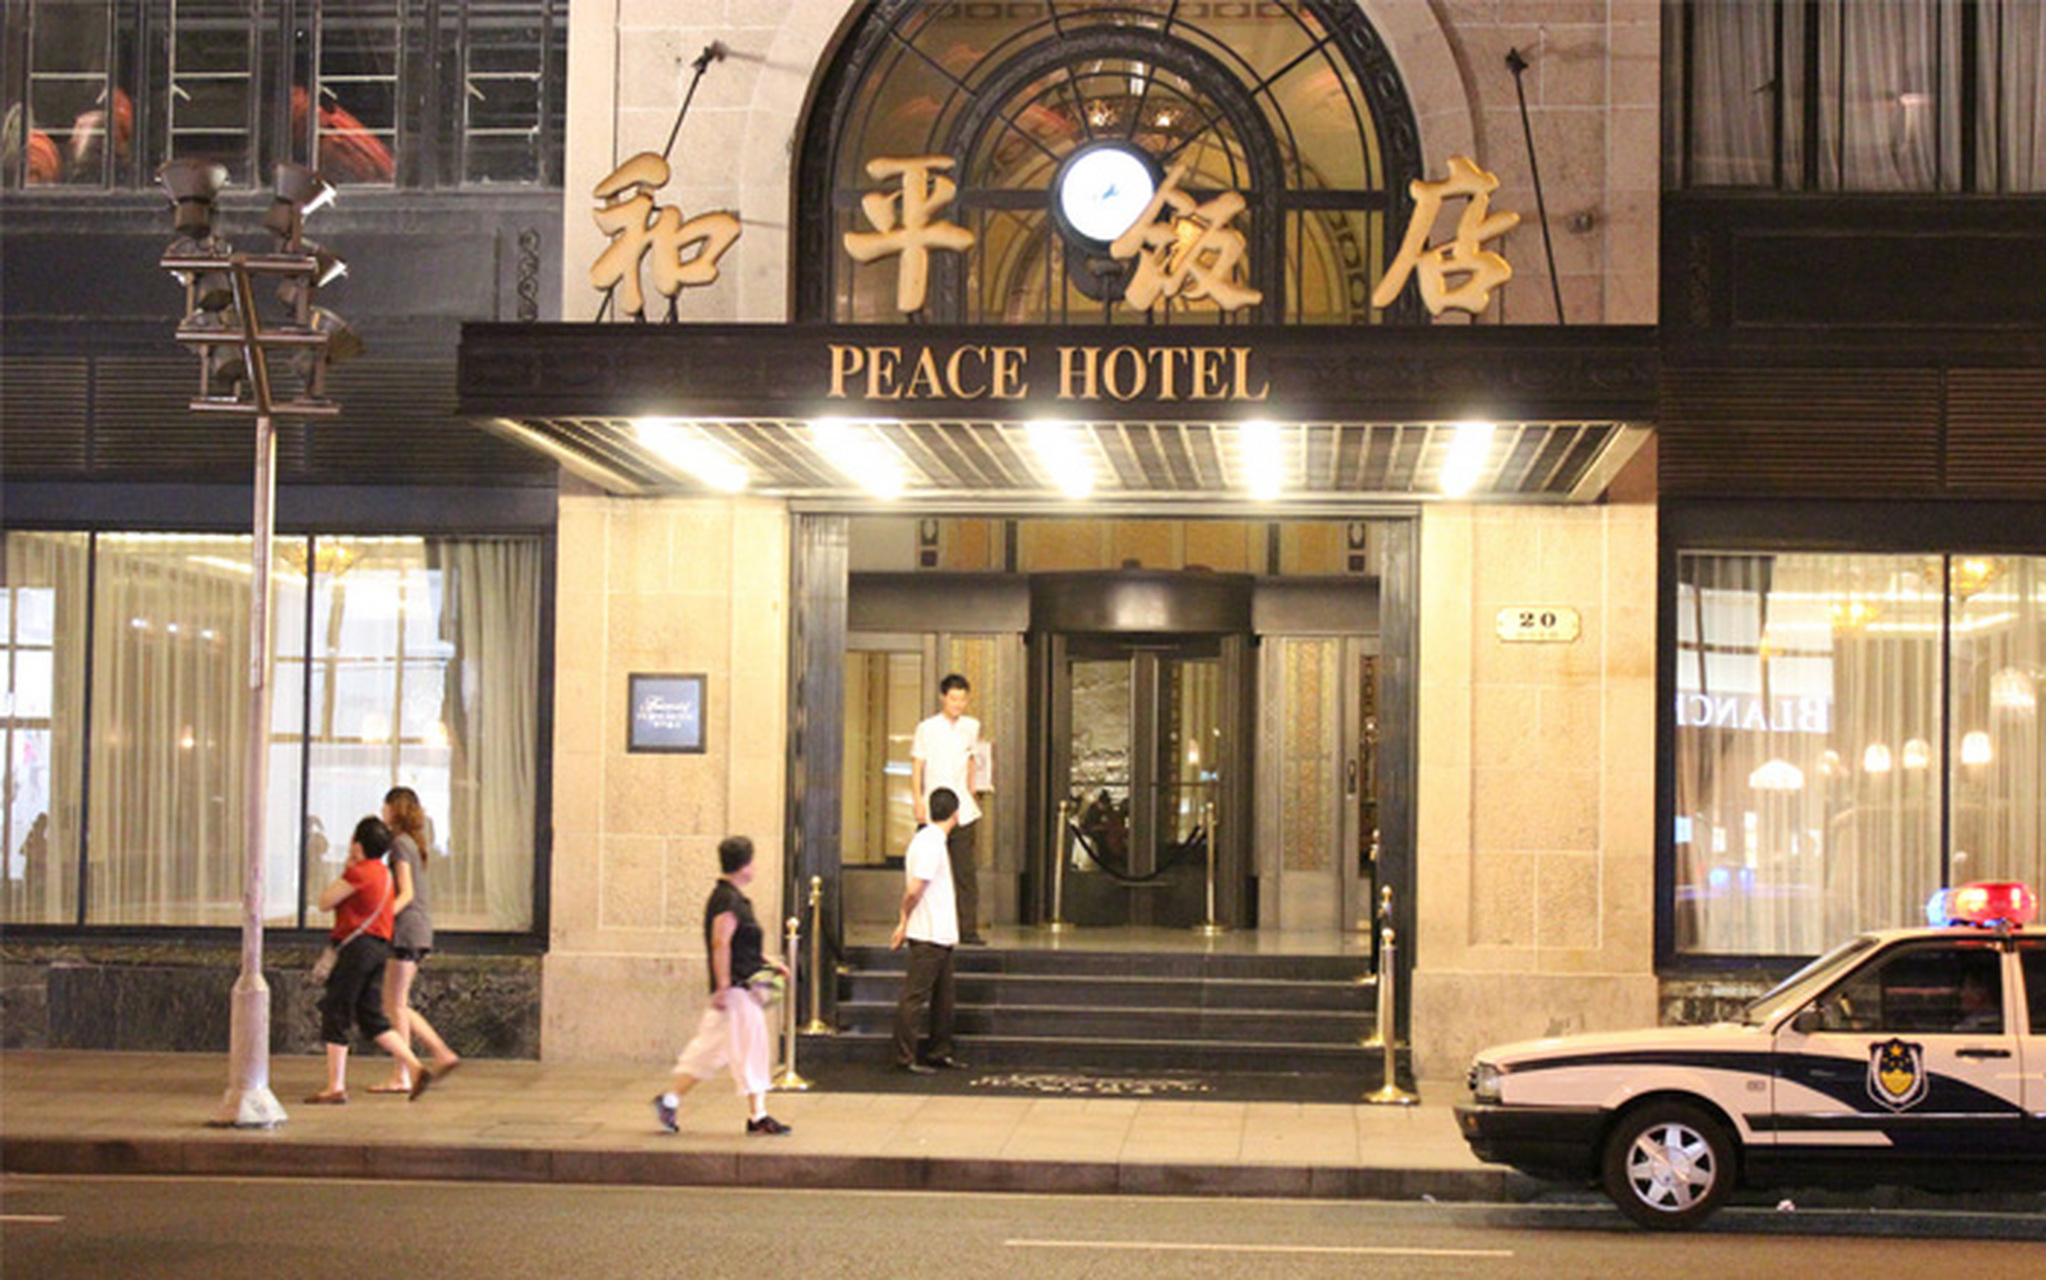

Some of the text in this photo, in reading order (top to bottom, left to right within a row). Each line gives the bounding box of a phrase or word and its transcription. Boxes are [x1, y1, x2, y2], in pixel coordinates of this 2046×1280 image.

[827, 344, 1270, 401] PEACE HOTEL
[1519, 611, 1557, 629] 20
